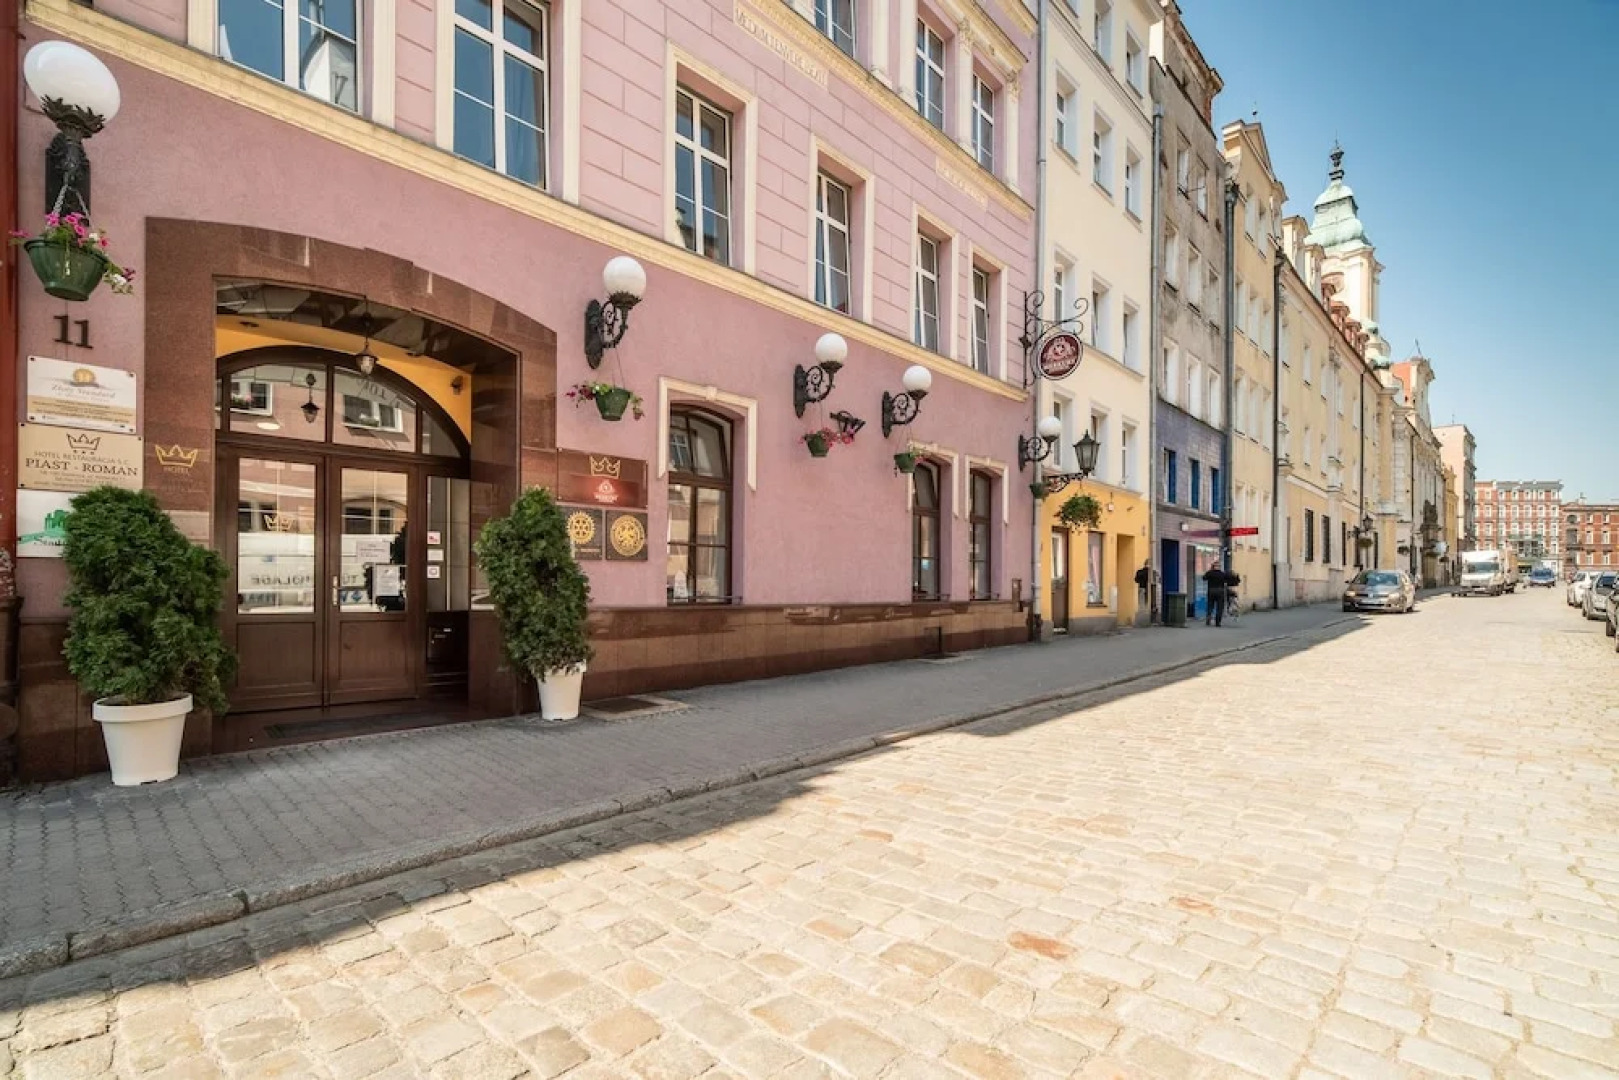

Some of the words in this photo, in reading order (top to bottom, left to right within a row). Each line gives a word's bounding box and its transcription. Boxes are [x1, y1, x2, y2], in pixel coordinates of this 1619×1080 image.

[53, 314, 94, 350] 11
[34, 451, 61, 460] HOTEL
[25, 457, 71, 471] PIAST
[82, 462, 139, 477] ROMAN
